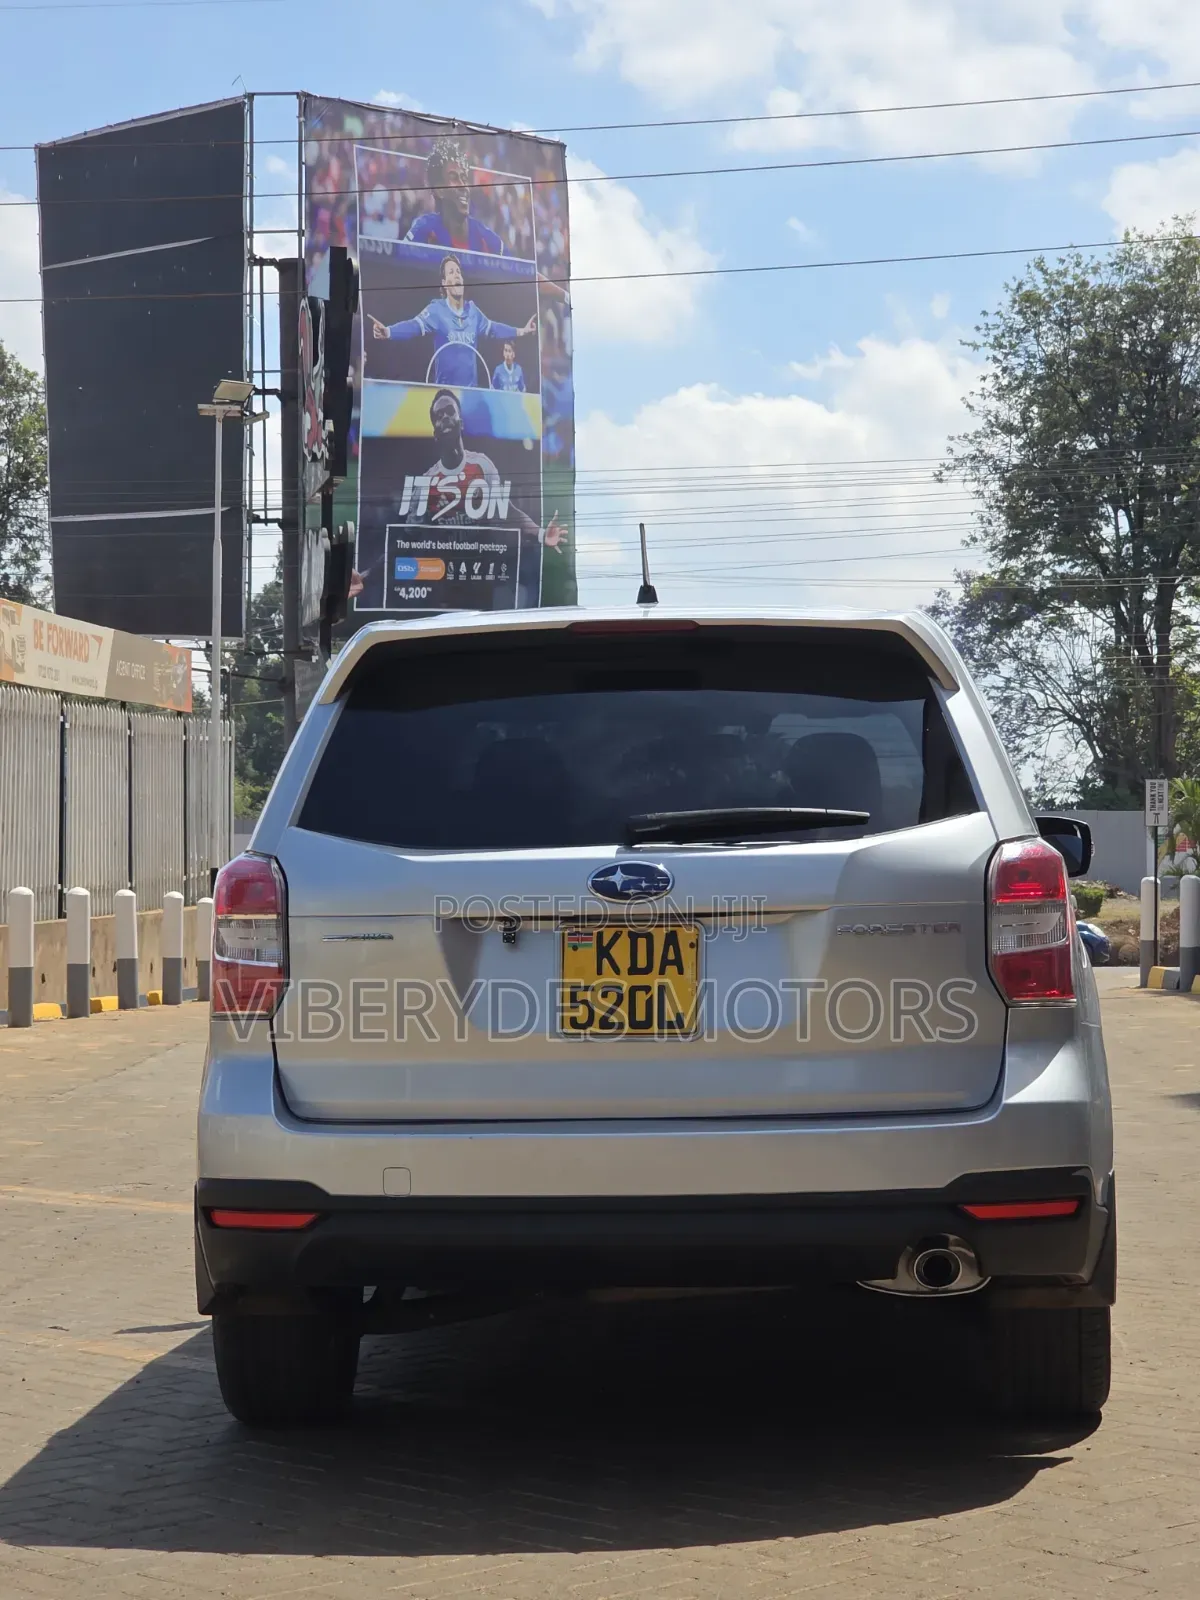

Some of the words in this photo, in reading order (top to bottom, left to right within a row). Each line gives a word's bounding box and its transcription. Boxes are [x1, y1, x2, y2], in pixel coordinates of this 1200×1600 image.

[399, 472, 466, 521] IT'S
[465, 478, 511, 520] ON
[396, 540, 410, 549] The
[411, 540, 436, 549] world's
[436, 540, 452, 550] best
[453, 541, 478, 550] football
[479, 542, 507, 554] package
[33, 619, 44, 652] BE
[47, 622, 89, 663] FORWARD
[1149, 781, 1157, 793] YOU
[1149, 793, 1157, 812] THANK
[1157, 791, 1165, 804] NEXT
[836, 921, 962, 937] FORESTER
[596, 930, 684, 976] KDA
[569, 985, 685, 1030] 520L
